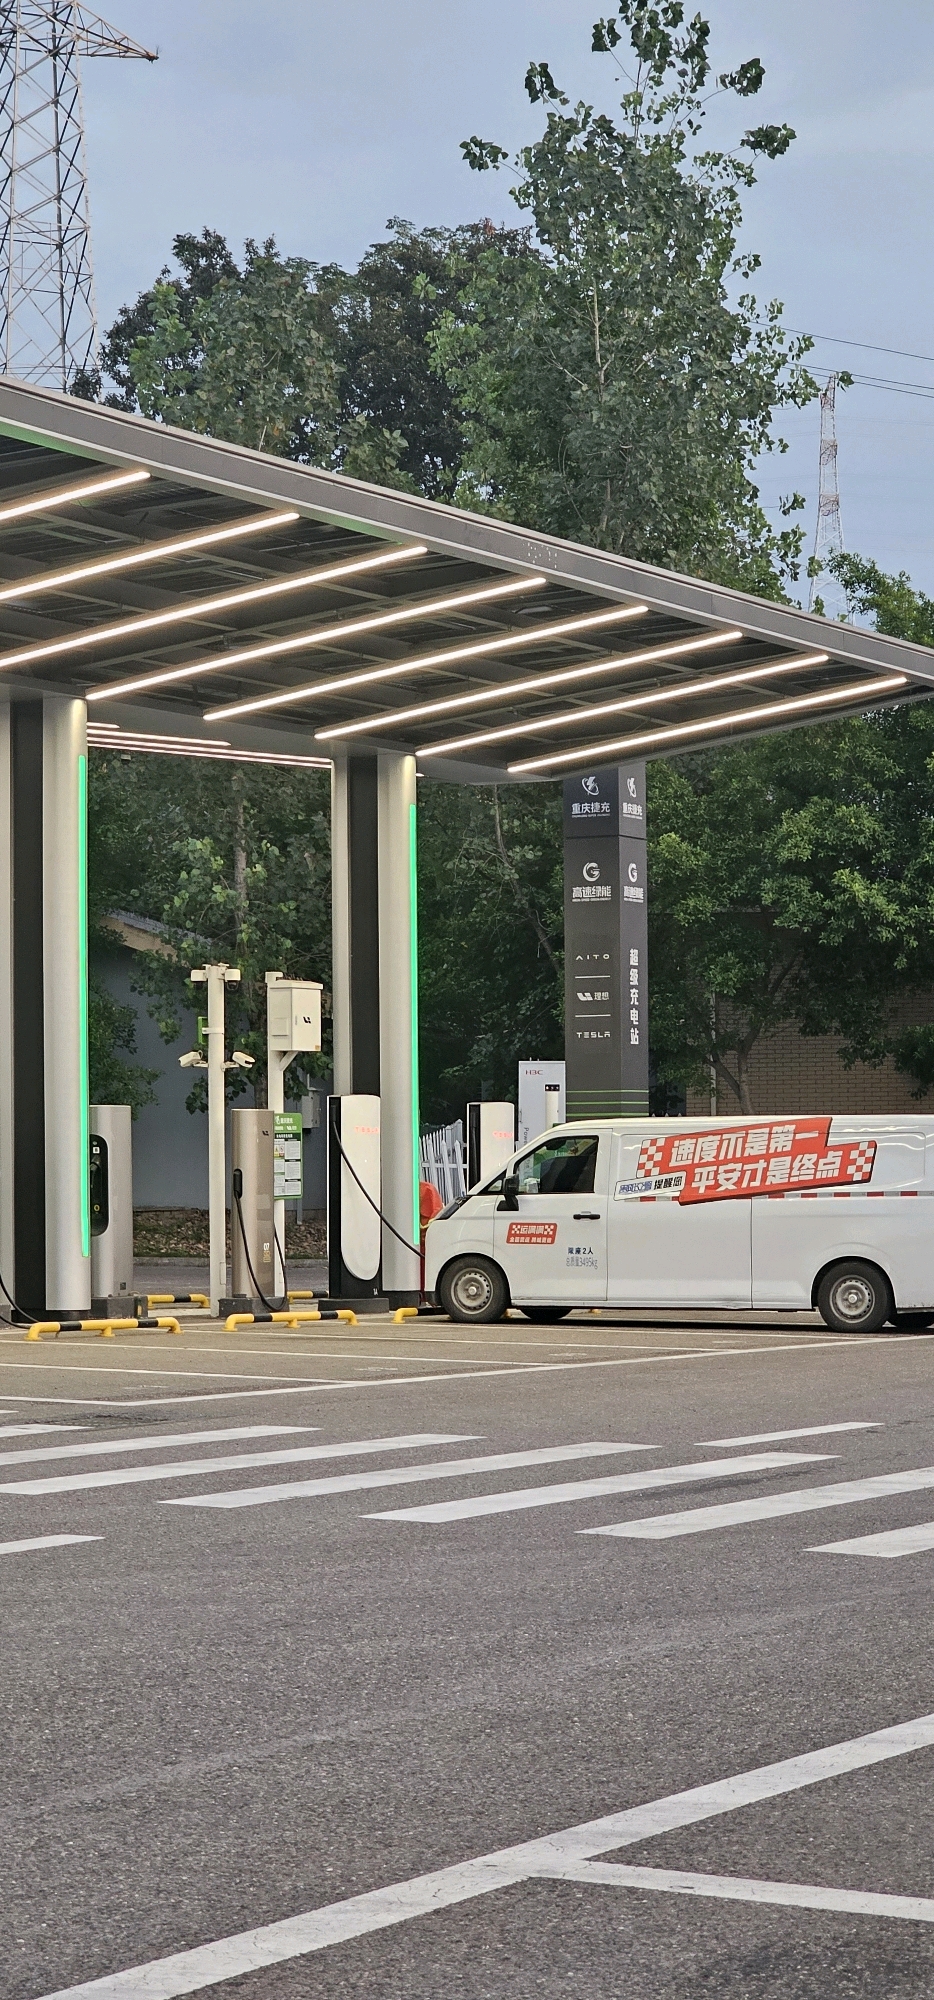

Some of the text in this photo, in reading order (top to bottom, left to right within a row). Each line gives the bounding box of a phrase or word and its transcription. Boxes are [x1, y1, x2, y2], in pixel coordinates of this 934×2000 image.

[572, 802, 610, 814] 重庆捷充
[572, 886, 611, 898] 高速绿能
[594, 992, 609, 1000] 理想
[630, 948, 639, 1045] 超级充电站
[669, 1124, 819, 1167] 速度不是第一
[691, 1150, 843, 1194] 平安才是终点
[653, 1174, 683, 1191] 提醒您
